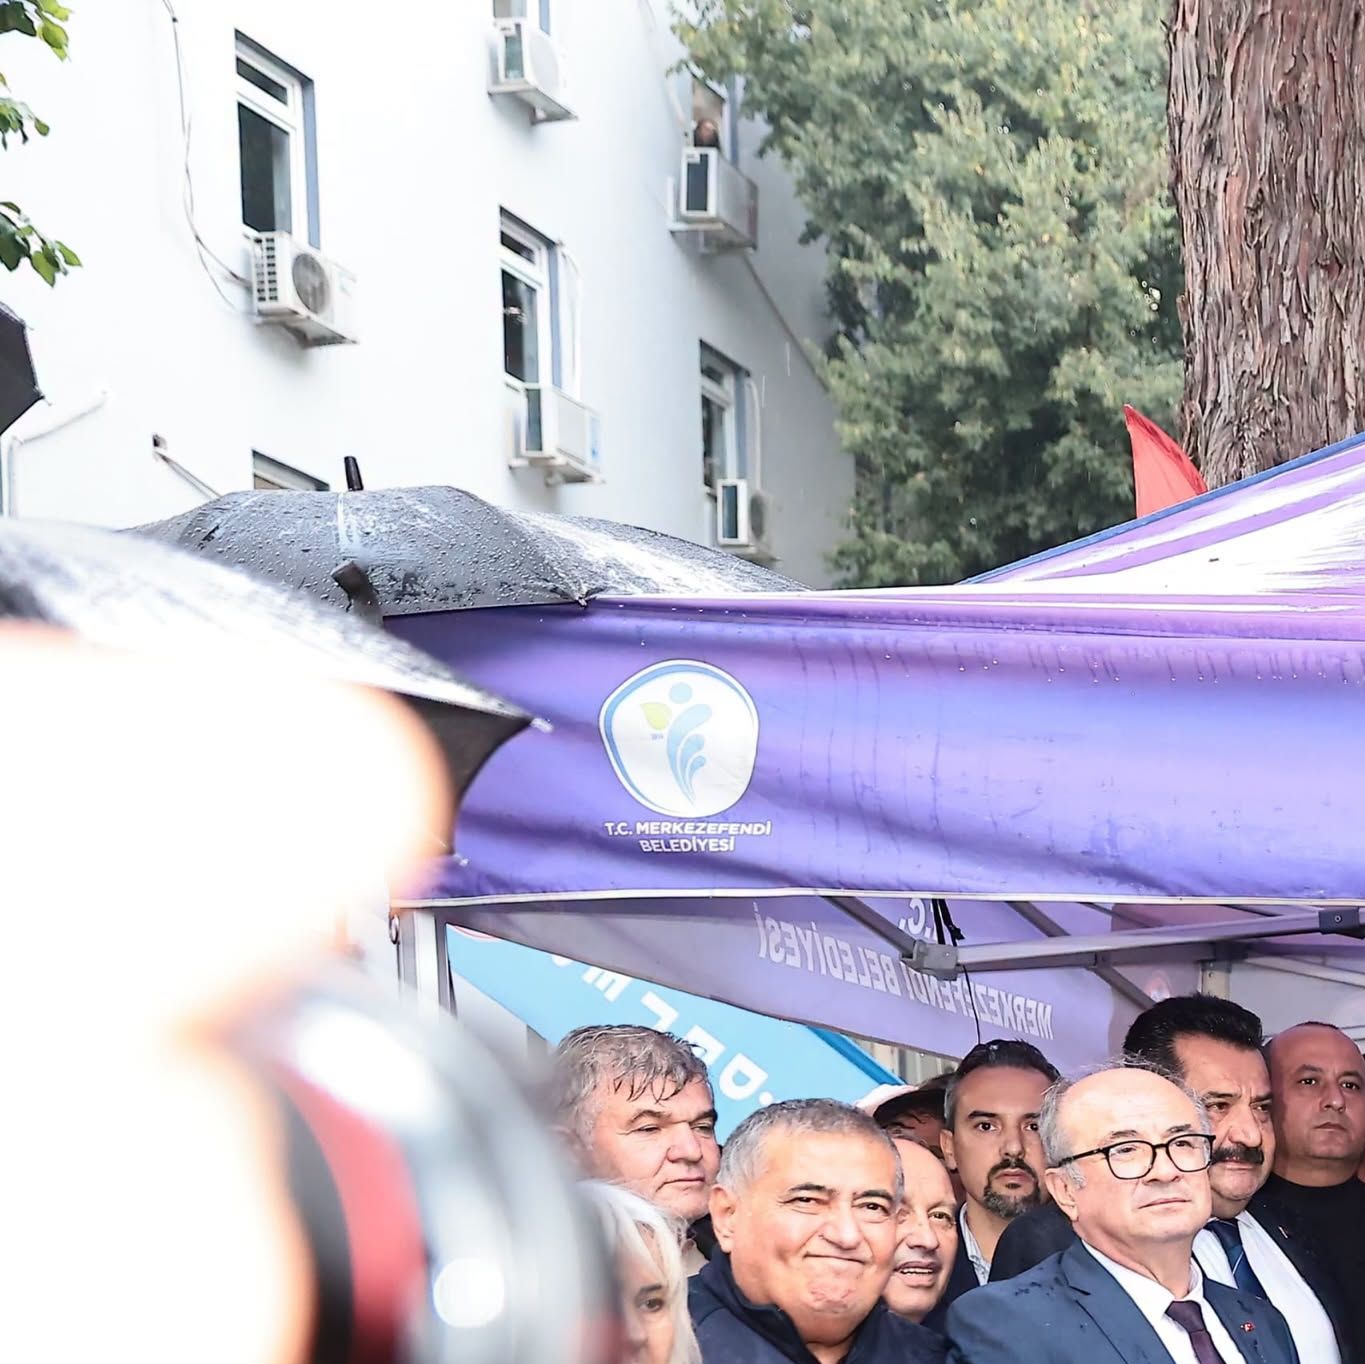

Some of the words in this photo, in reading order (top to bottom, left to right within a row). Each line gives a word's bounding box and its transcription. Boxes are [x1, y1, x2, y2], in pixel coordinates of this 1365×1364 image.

[604, 822, 632, 836] T.C.
[636, 821, 771, 836] MERKEZEFENDİ
[639, 836, 735, 852] BELEDİYESİ
